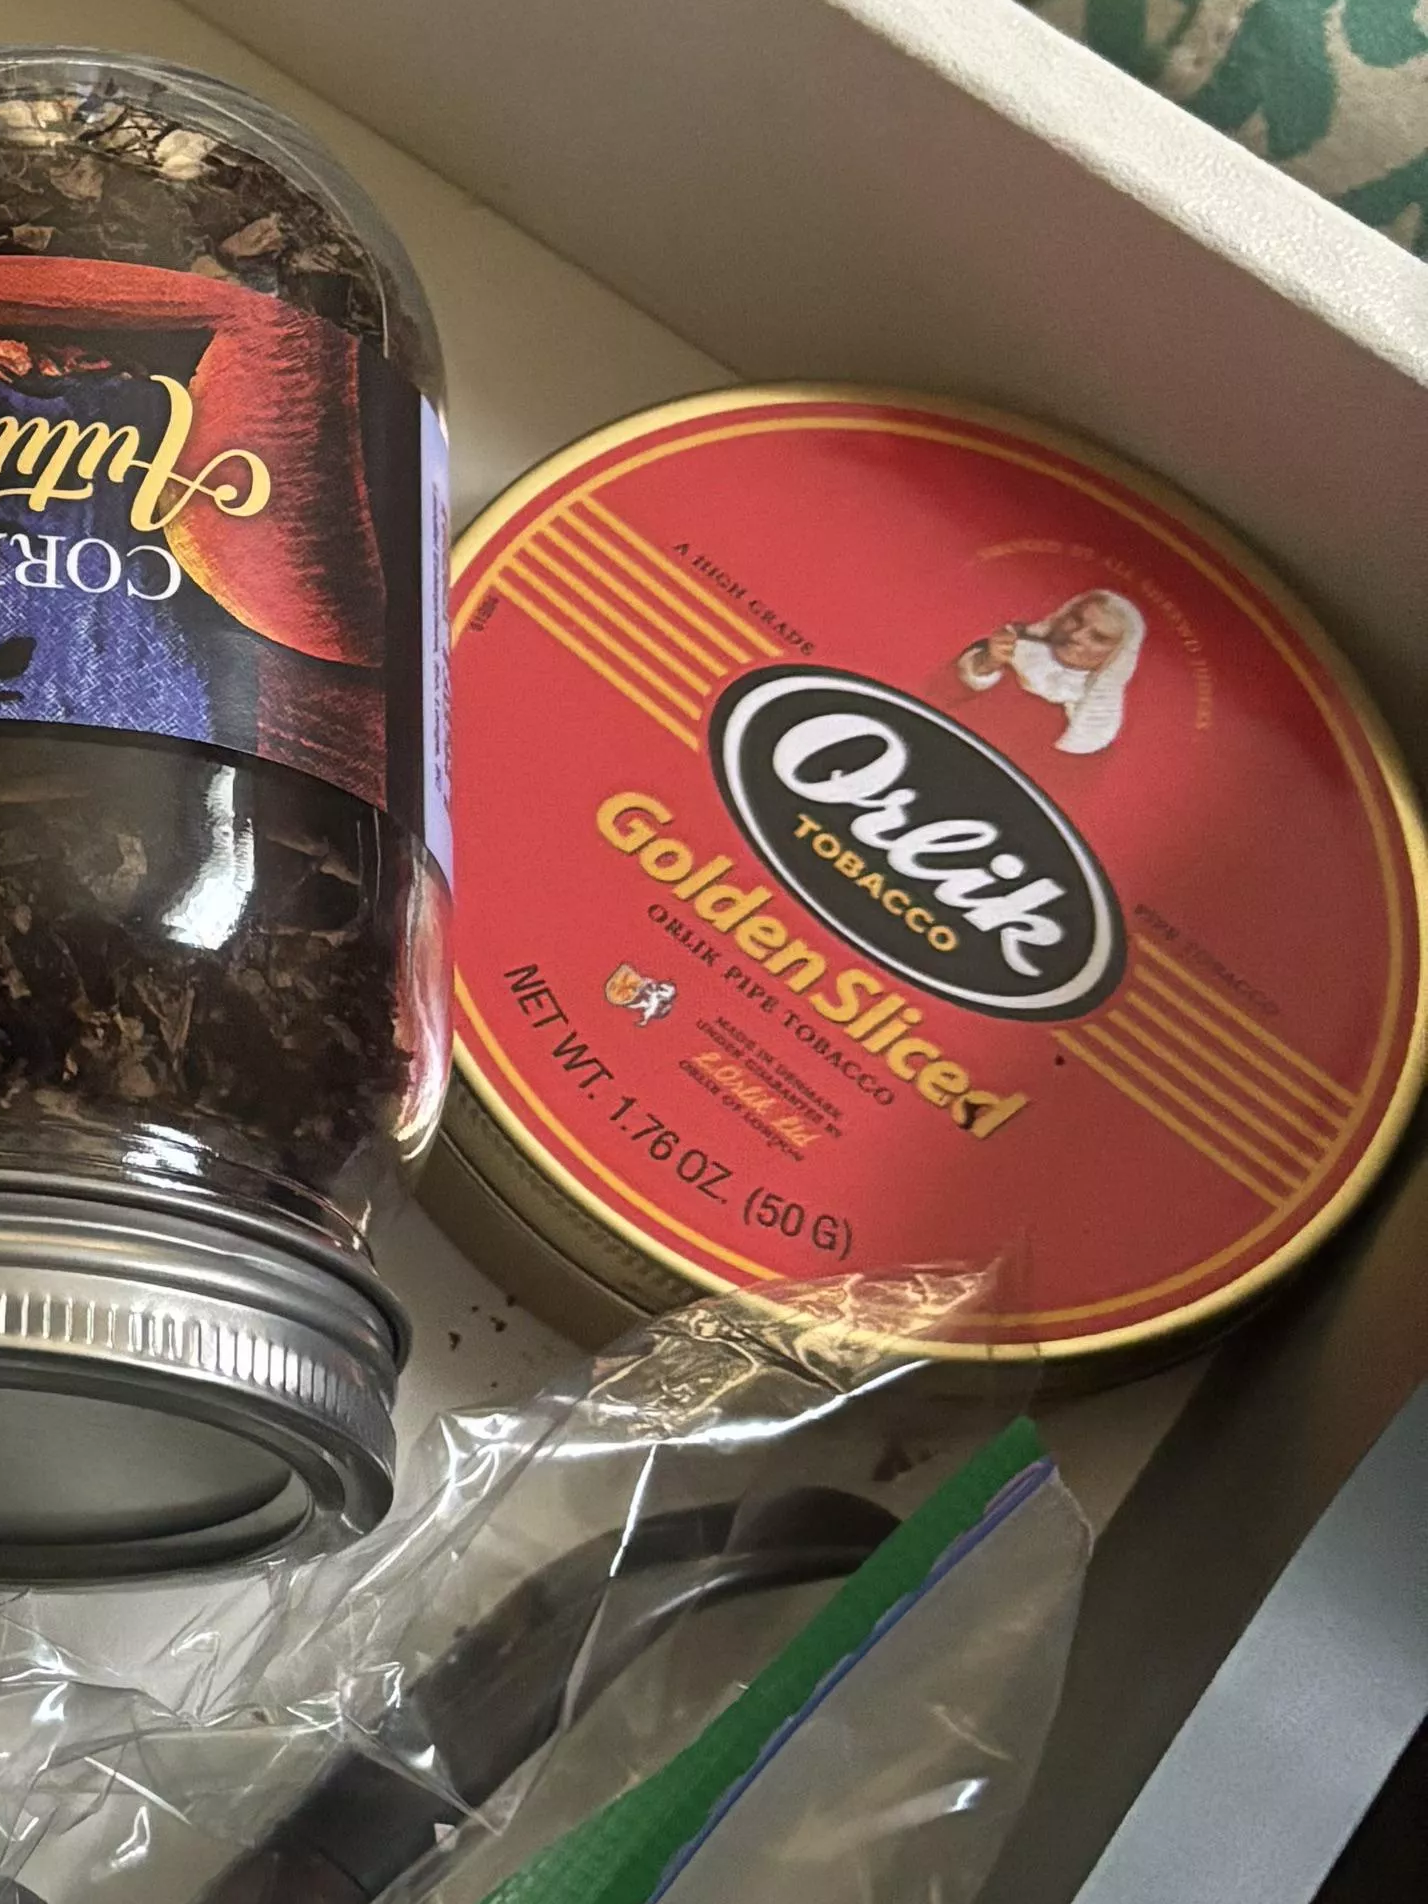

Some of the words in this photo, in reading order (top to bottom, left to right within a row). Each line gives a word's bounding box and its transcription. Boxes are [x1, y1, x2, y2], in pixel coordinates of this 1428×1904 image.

[690, 552, 748, 601] HIGH
[746, 596, 816, 658] GRADE
[773, 713, 1067, 977] Orlik
[793, 813, 958, 953] TOBACCO
[596, 792, 827, 996] Golden
[810, 968, 1032, 1139] Sliced
[644, 901, 722, 968] ORLIK
[721, 963, 780, 1015] PIPE
[781, 1010, 896, 1108] TOBACCO
[504, 964, 569, 1029] NET
[552, 1032, 614, 1099] WT.
[610, 1097, 680, 1162] 1.76
[676, 1149, 732, 1204] OZ.
